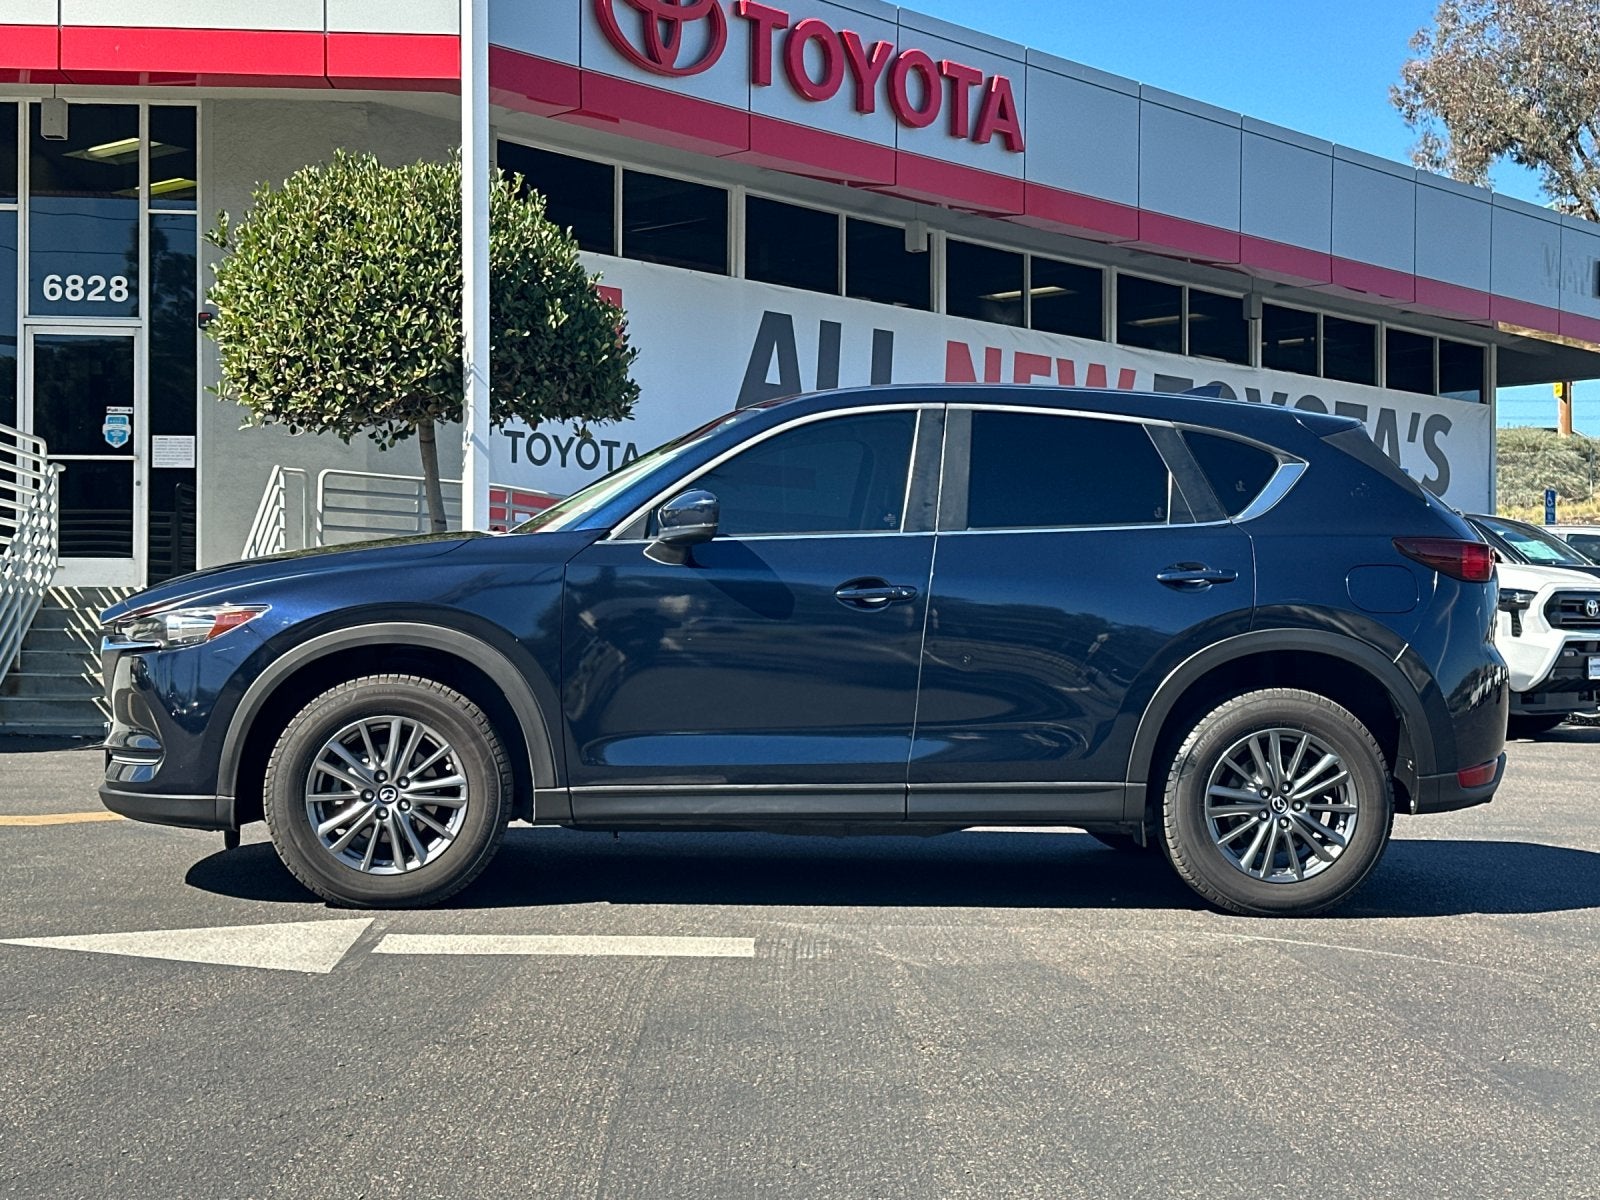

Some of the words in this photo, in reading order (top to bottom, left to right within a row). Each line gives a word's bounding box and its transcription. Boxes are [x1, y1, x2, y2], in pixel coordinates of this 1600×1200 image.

[736, 0, 1025, 152] TOYOTA
[43, 274, 129, 302] 6828
[504, 430, 639, 471] TOYOTA
